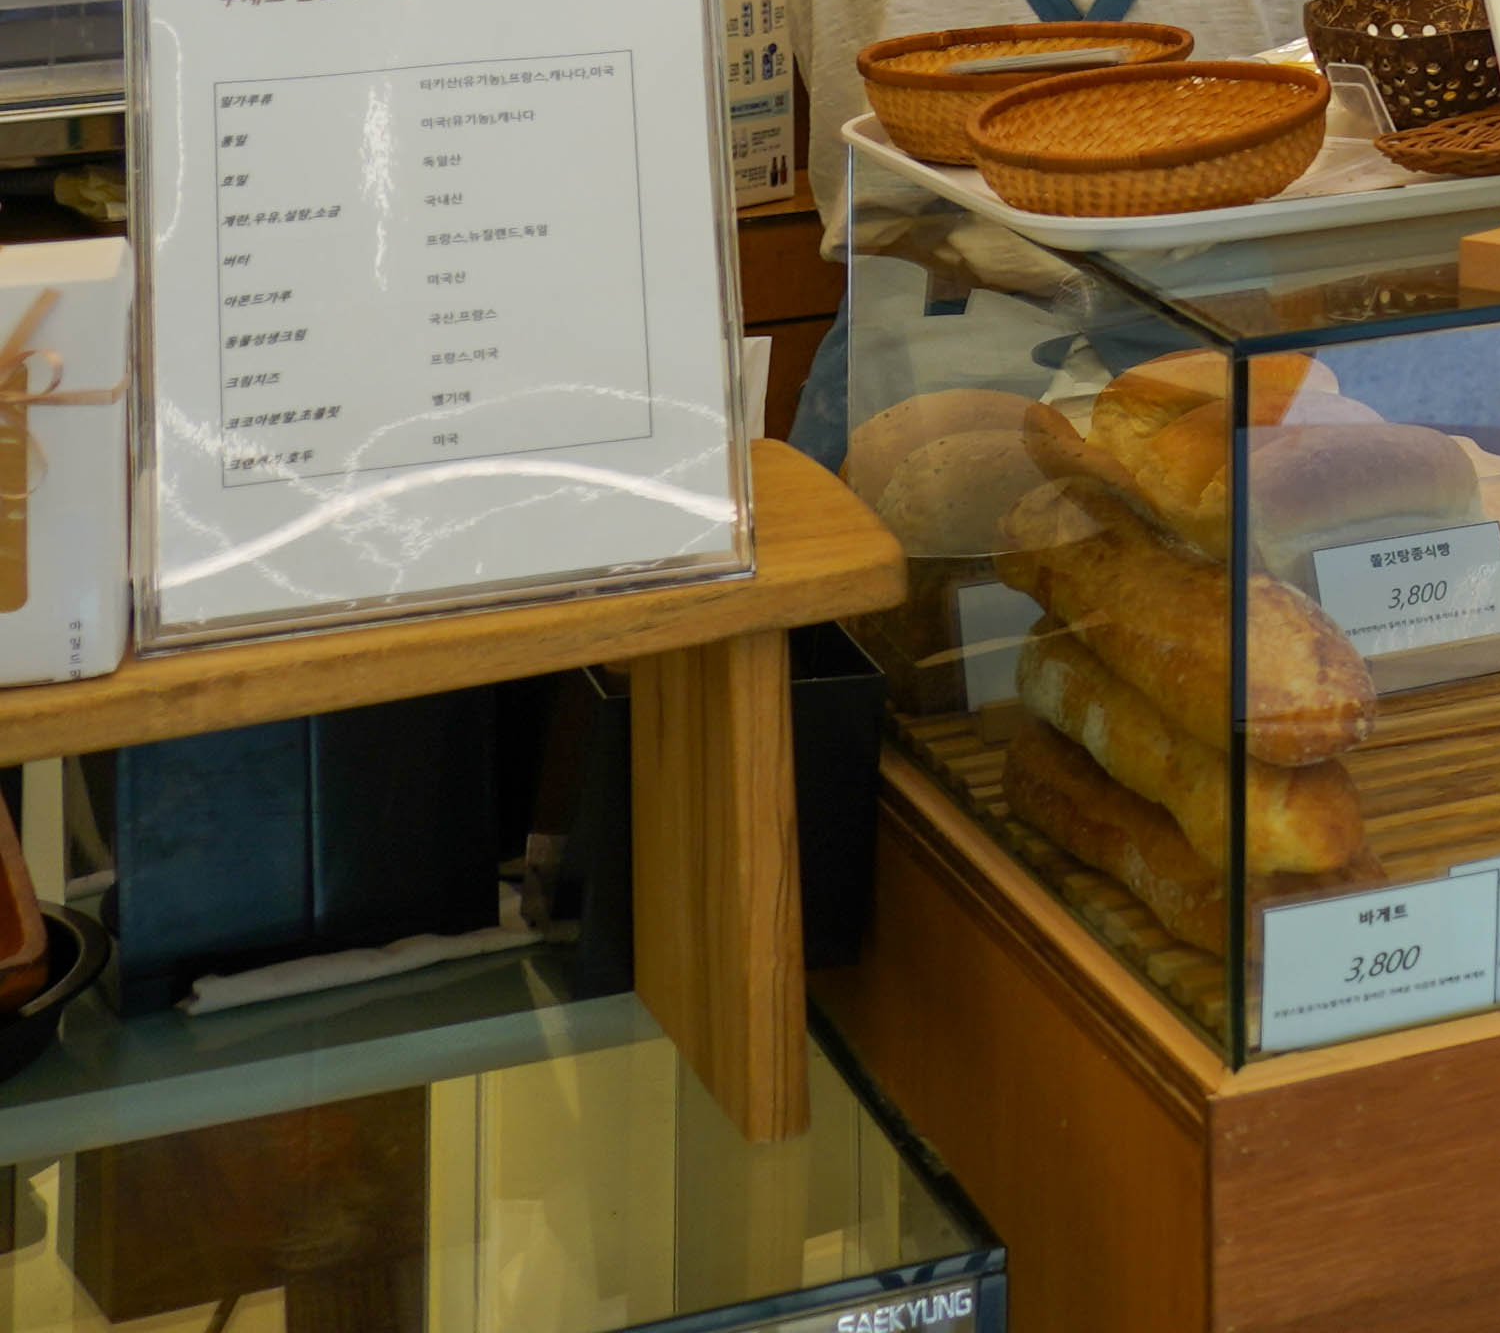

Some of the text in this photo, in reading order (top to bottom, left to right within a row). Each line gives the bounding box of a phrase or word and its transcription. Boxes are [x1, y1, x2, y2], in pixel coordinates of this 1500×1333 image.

[1370, 542, 1451, 568] 쫄깃탕종식빵
[1388, 580, 1447, 610] 3,800
[1359, 903, 1408, 925] 바게트
[1344, 944, 1420, 984] 3,800
[838, 1288, 972, 1333] SAEKYUNG
